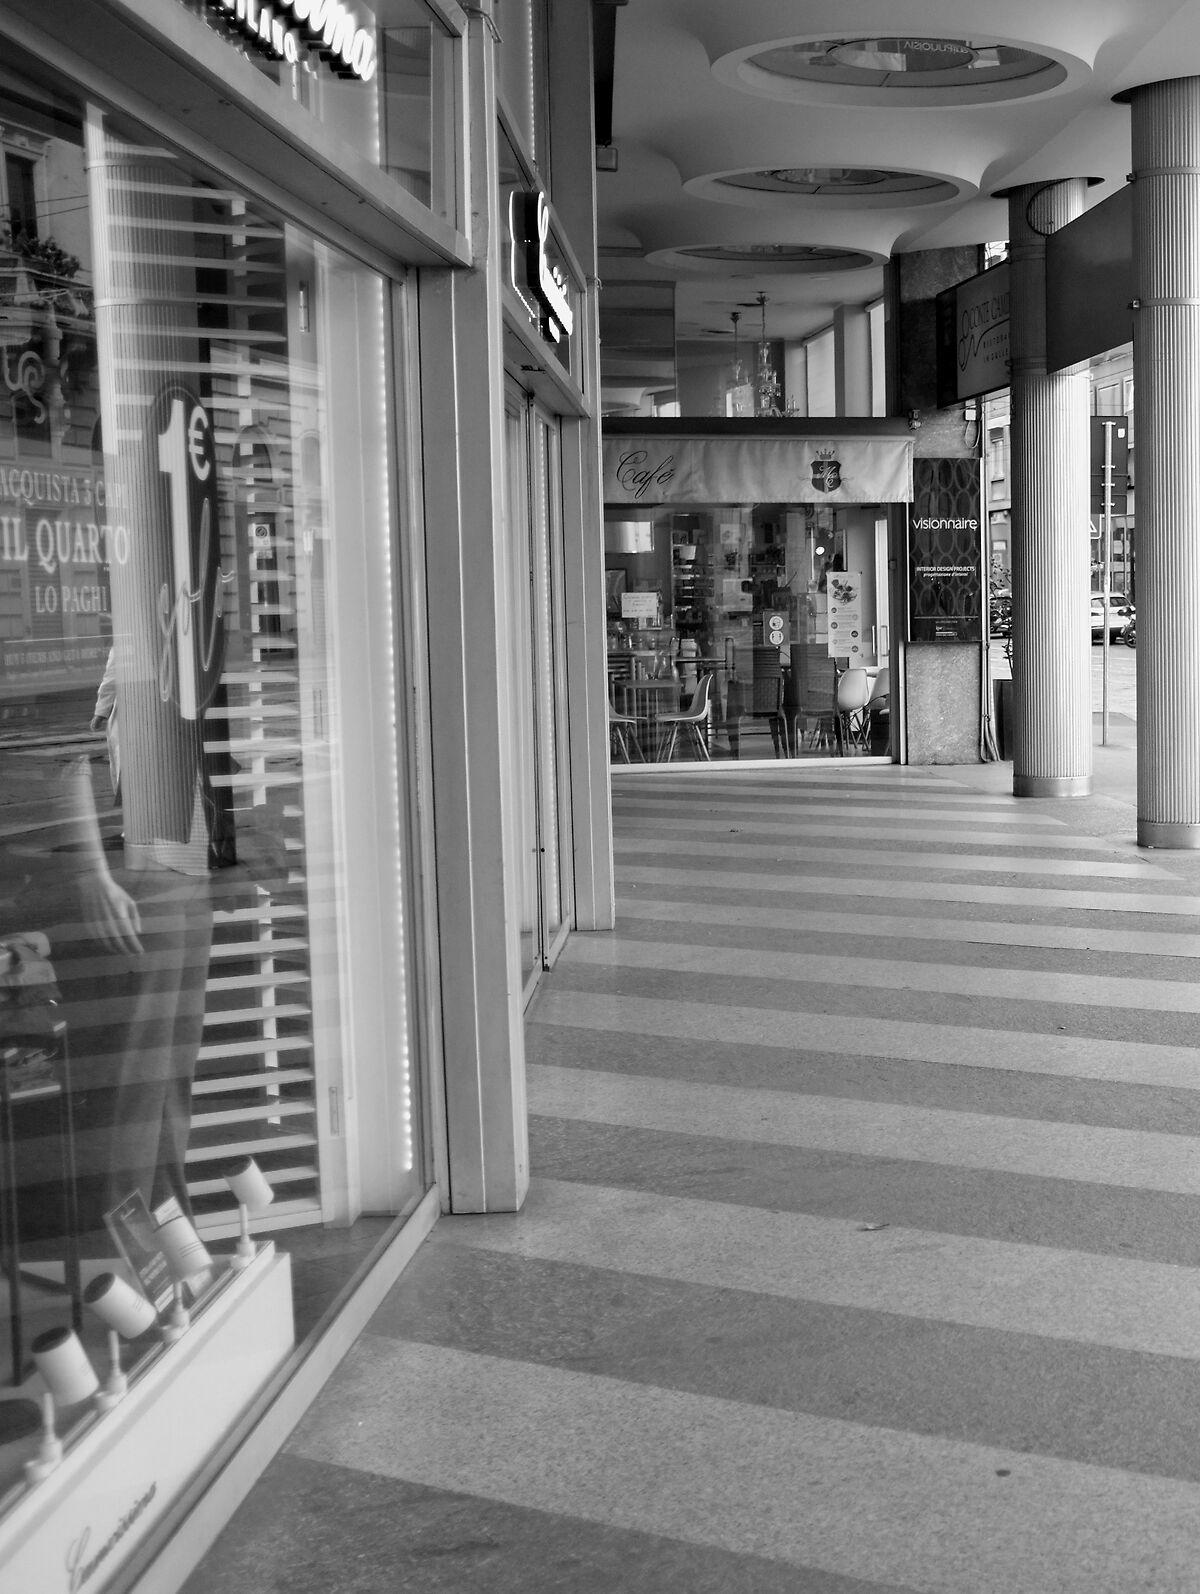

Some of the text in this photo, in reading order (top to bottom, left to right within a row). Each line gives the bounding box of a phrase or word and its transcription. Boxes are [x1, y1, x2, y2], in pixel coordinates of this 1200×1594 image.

[616, 450, 676, 500] Café
[912, 517, 978, 532] visionnaire
[36, 519, 129, 574] QUARTO
[35, 585, 107, 613] LO PAGHI
